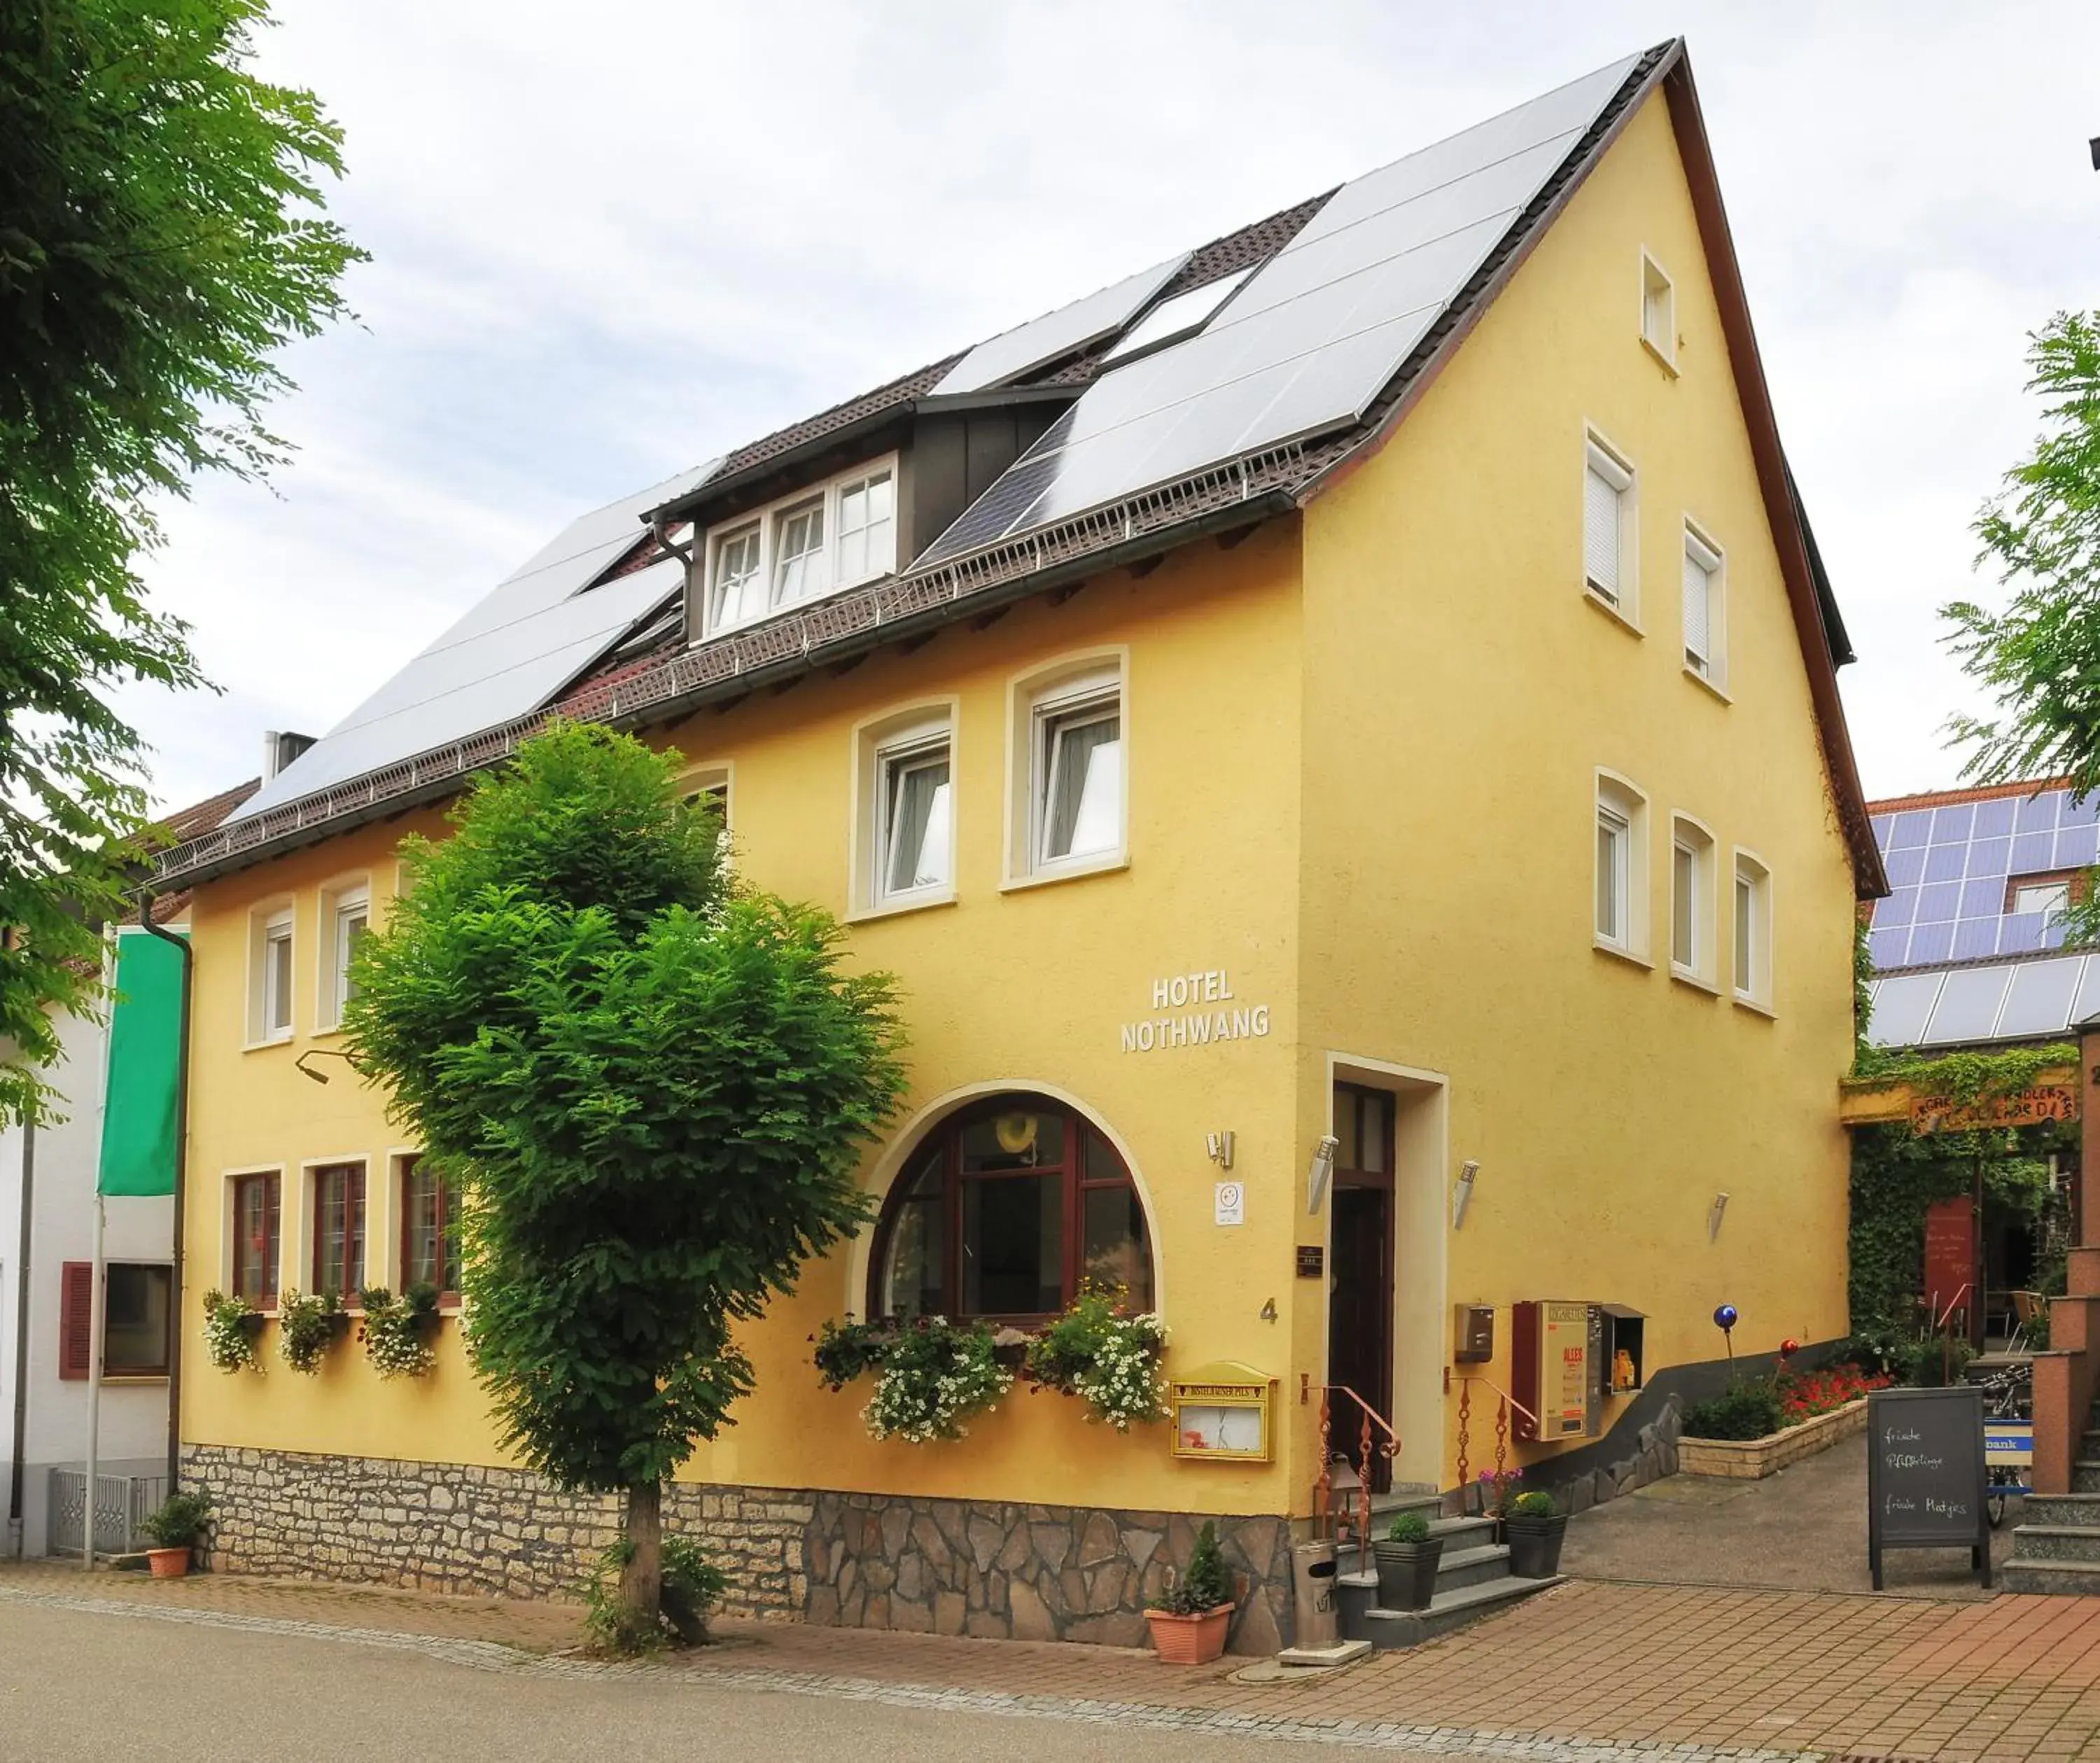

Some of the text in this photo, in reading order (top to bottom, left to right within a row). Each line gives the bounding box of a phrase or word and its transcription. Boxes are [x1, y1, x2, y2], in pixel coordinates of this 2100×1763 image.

[1152, 970, 1233, 1010] HOTEL
[1121, 1005, 1269, 1053] NOTHWANG
[1260, 1297, 1278, 1324] 4
[1926, 1498, 1967, 1519] Matjes
